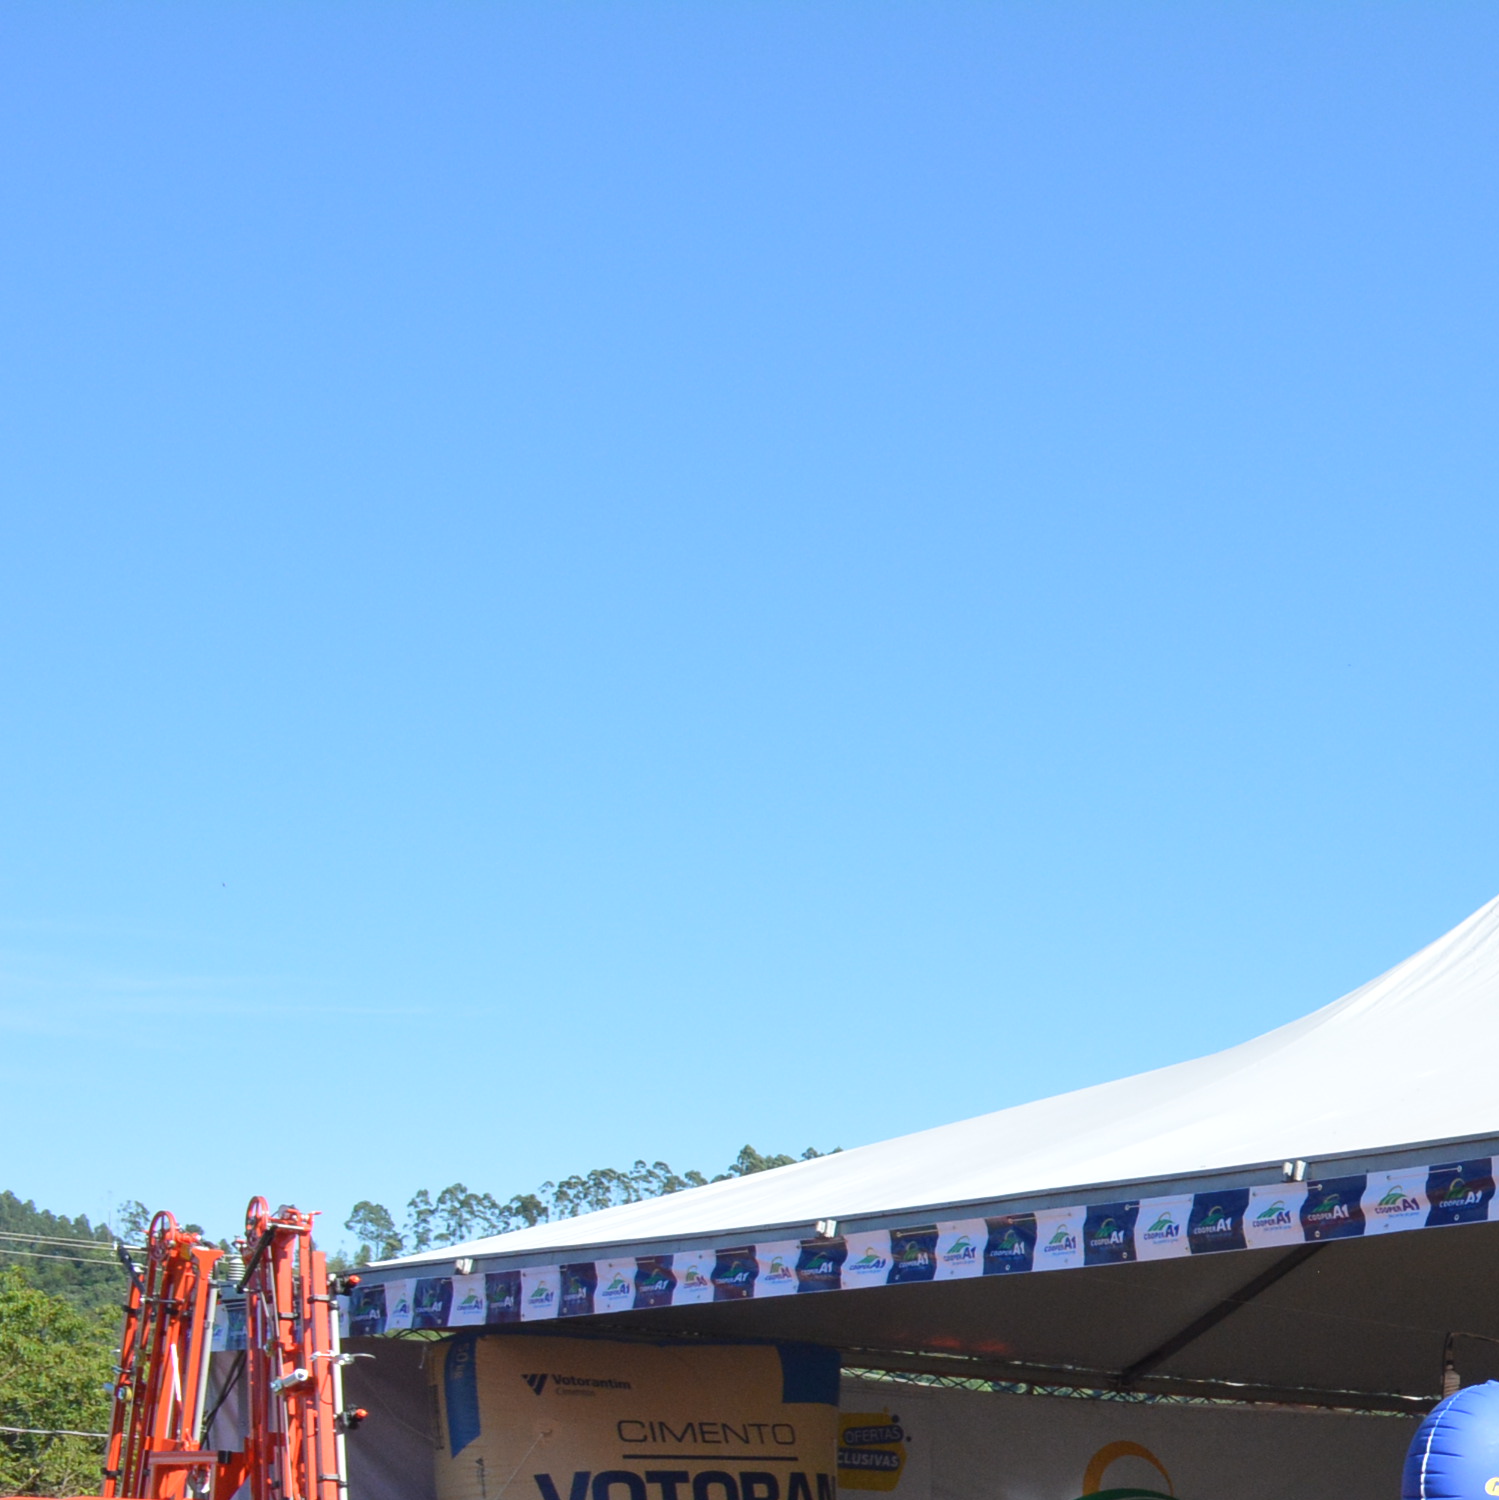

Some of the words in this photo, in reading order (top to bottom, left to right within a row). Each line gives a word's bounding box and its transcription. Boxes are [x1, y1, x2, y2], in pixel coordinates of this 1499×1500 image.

[551, 1374, 632, 1390] Votorantim
[617, 1419, 796, 1445] CIMENTO
[844, 1427, 900, 1443] OFERTAS
[837, 1452, 899, 1468] CLUSIVAS
